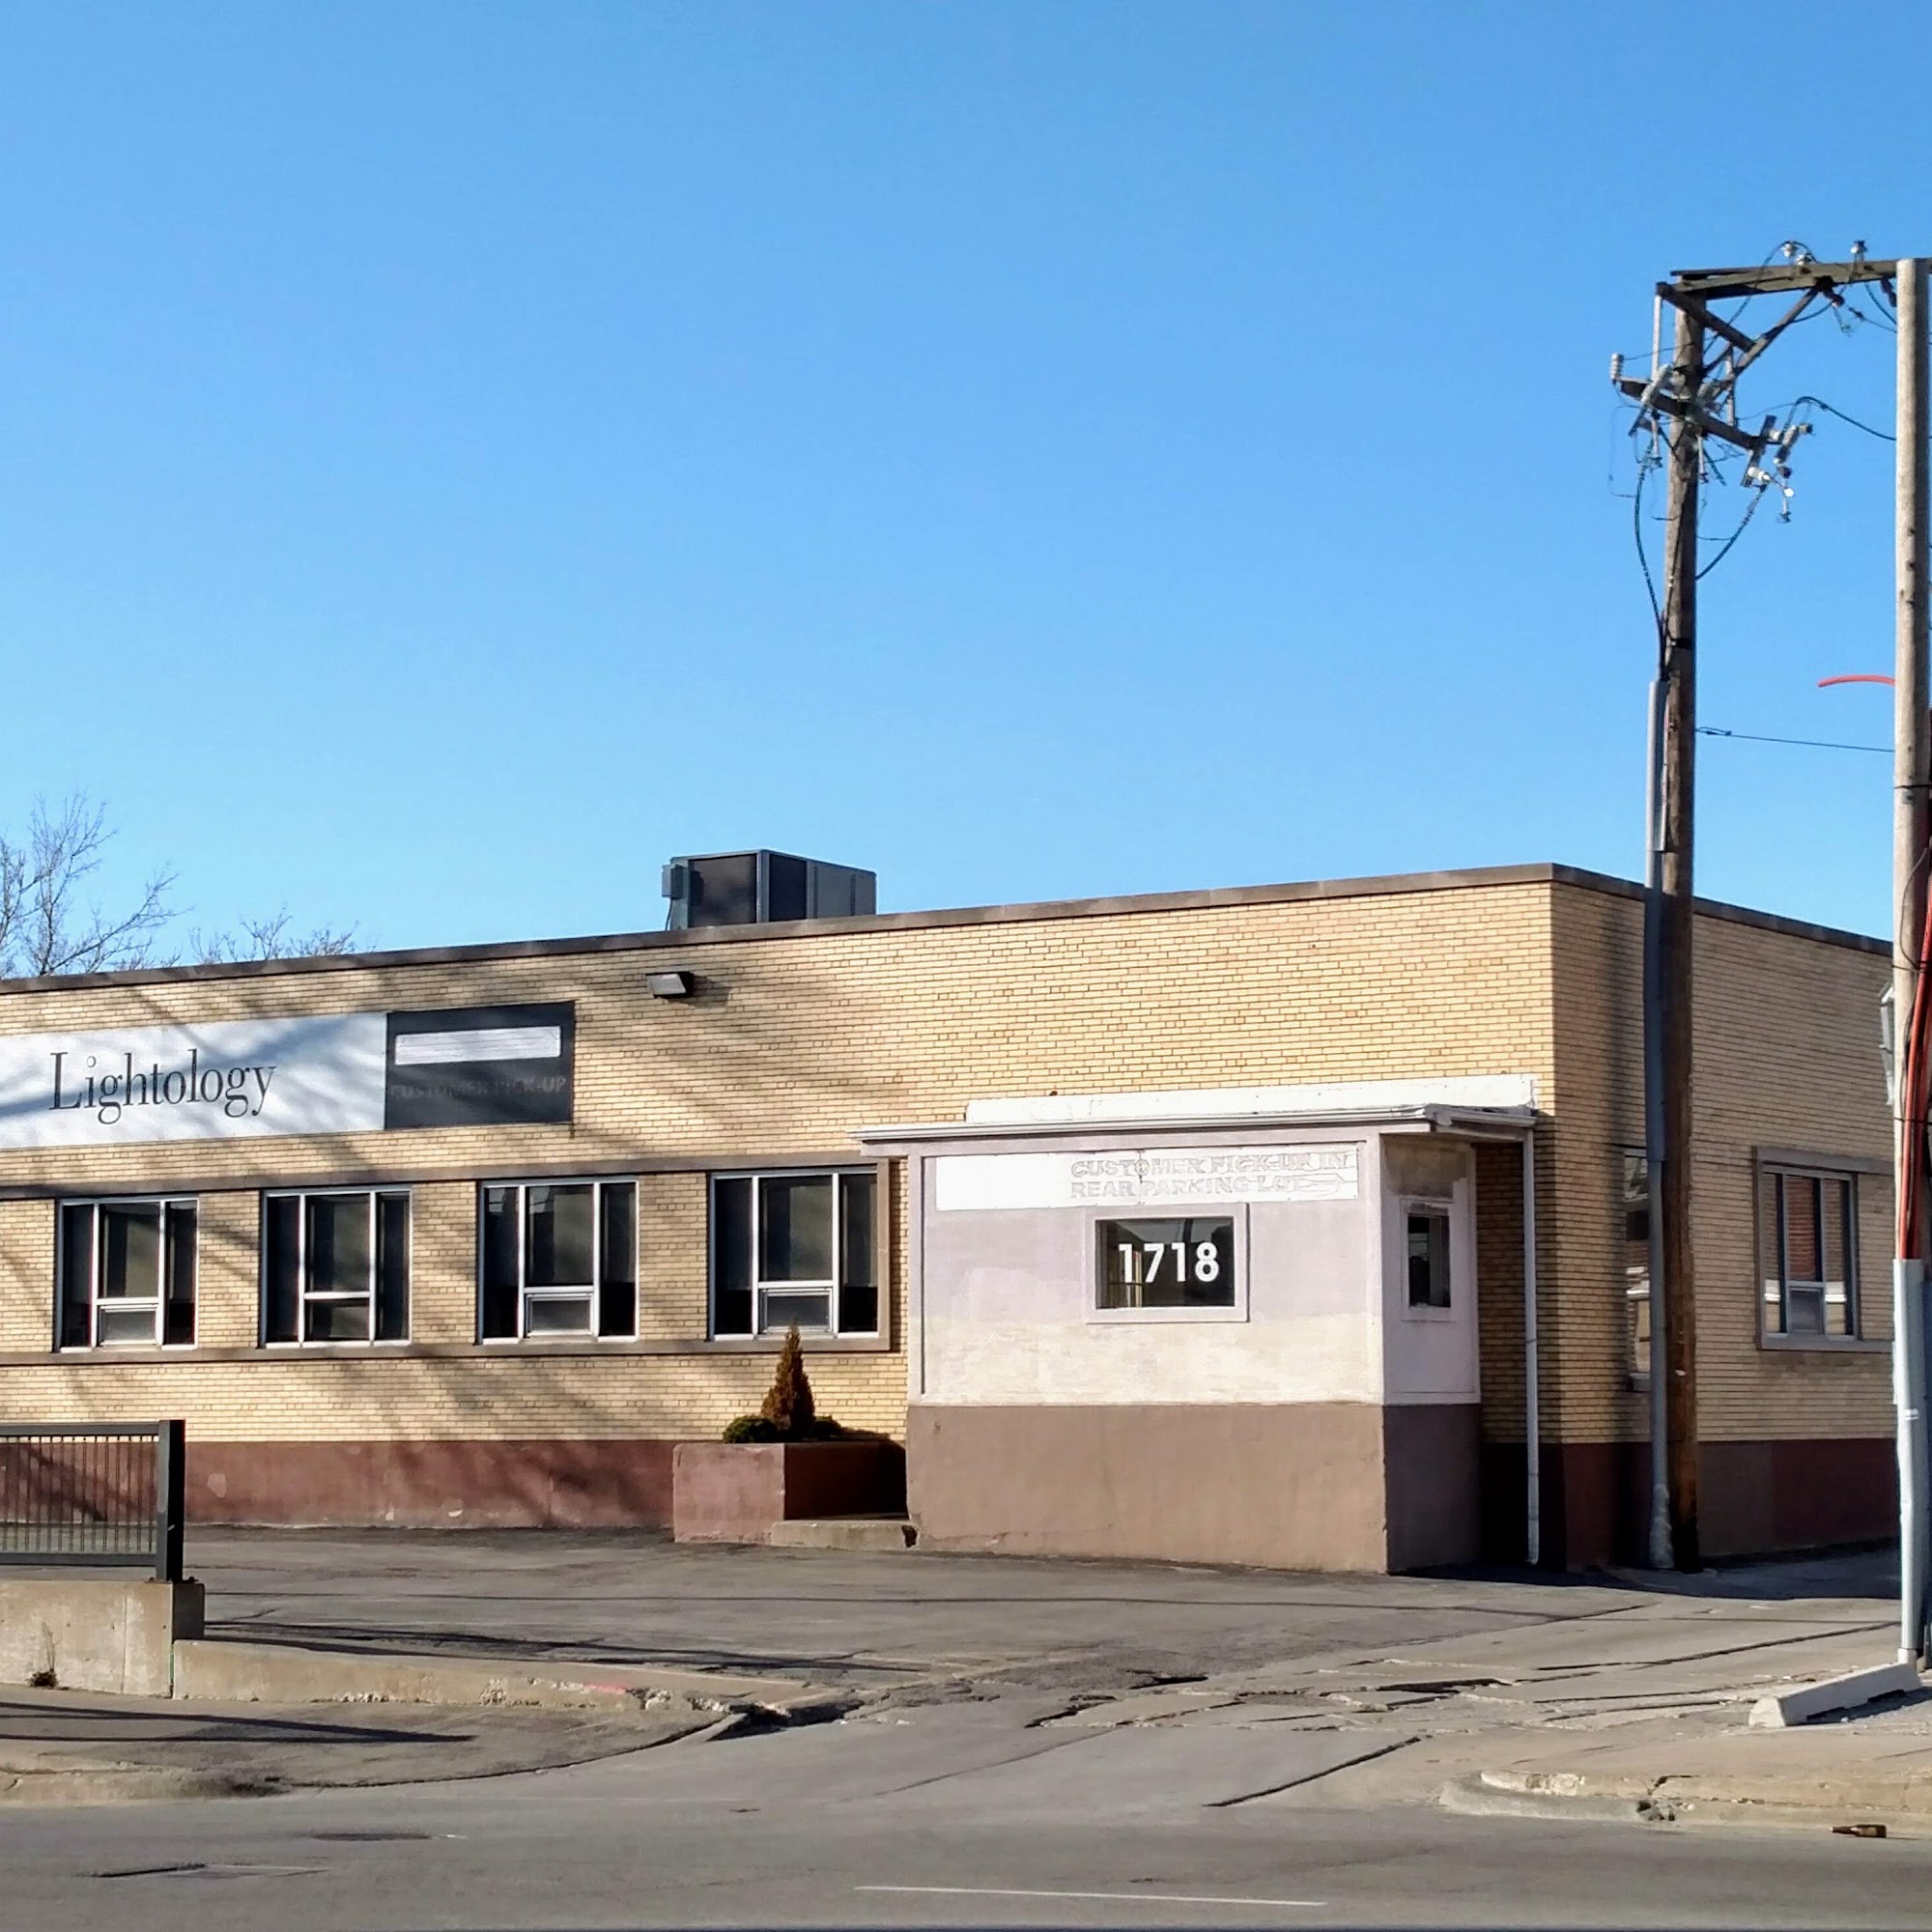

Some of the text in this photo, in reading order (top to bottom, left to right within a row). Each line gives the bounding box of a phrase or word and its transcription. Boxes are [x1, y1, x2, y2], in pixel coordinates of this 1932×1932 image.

[49, 1048, 276, 1124] Lightology
[1071, 1158, 1206, 1178] CUSTOMER
[1070, 1179, 1137, 1199] REAR
[1142, 1176, 1250, 1197] PARKING
[1119, 1241, 1219, 1283] 1718
